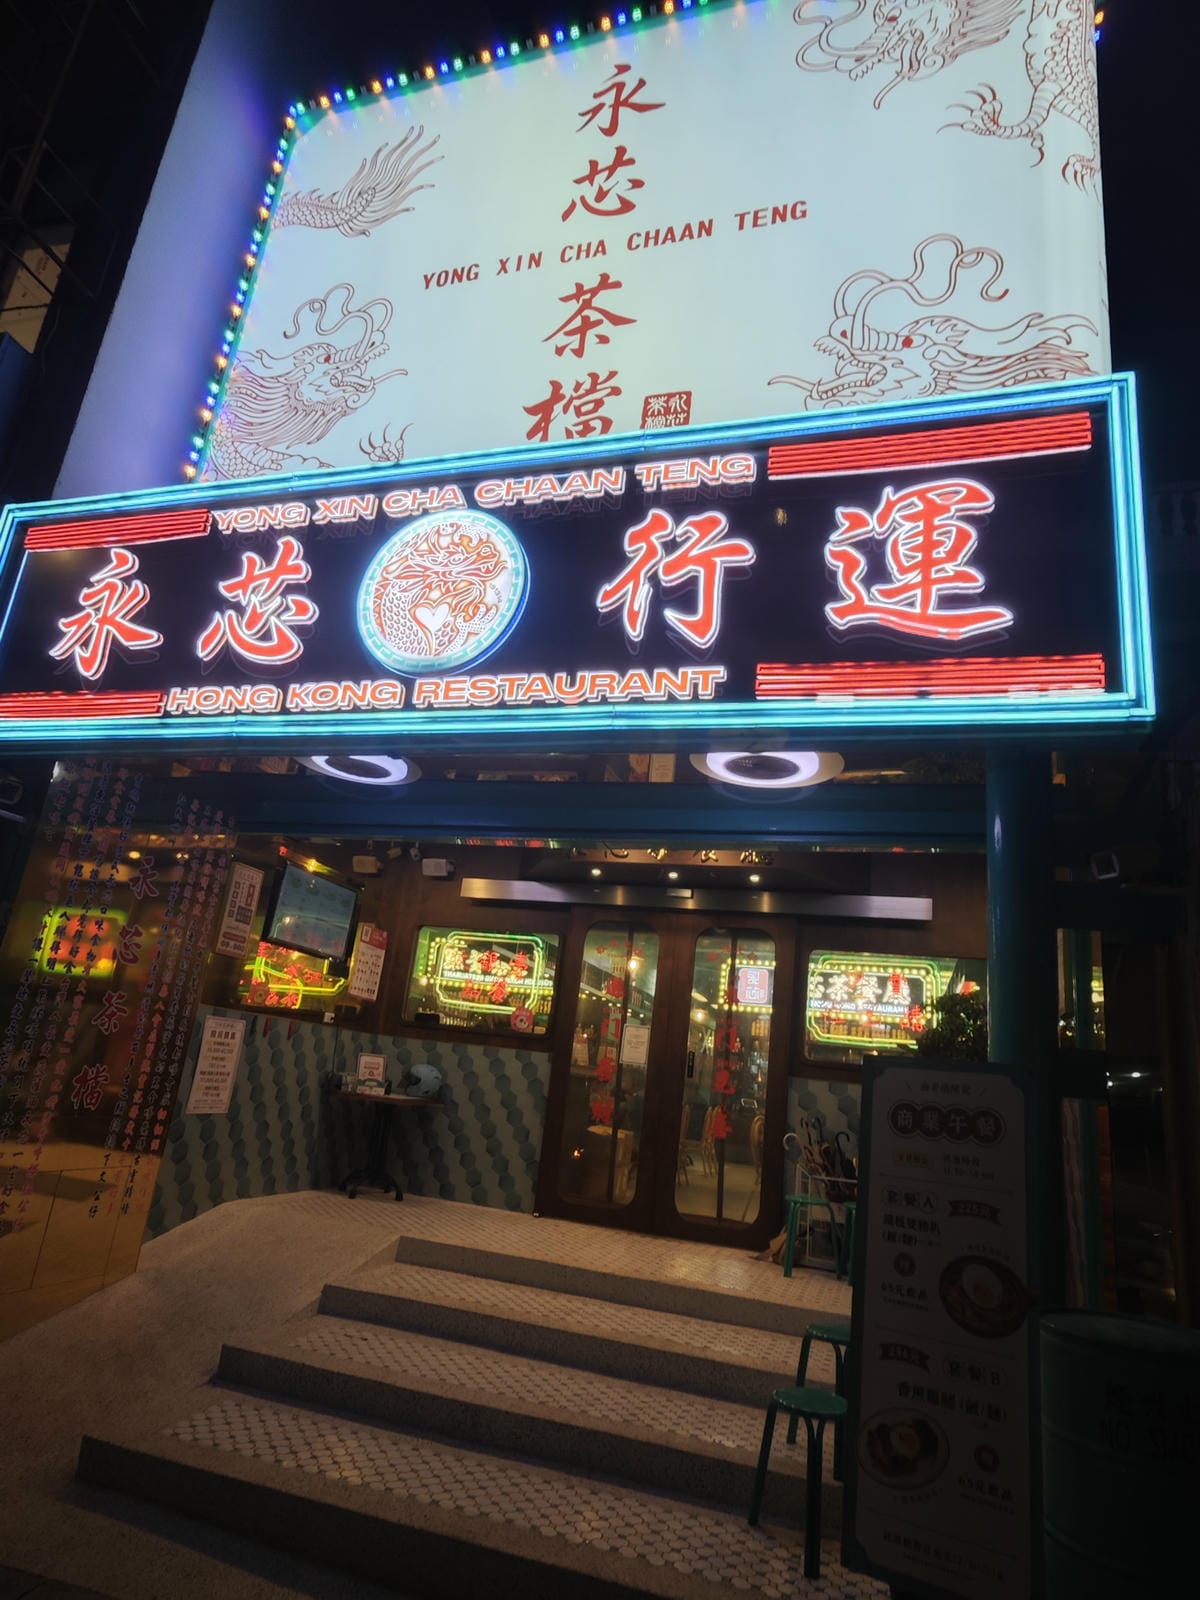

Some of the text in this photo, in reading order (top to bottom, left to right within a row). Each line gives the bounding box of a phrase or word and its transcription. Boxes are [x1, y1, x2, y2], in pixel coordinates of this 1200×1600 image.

[423, 200, 809, 290] YONG XIN CHA CHAAN TENG
[212, 453, 756, 534] YONG XIN CHA CHAAN TENG
[167, 666, 727, 716] HONG KONG RESTAURANT
